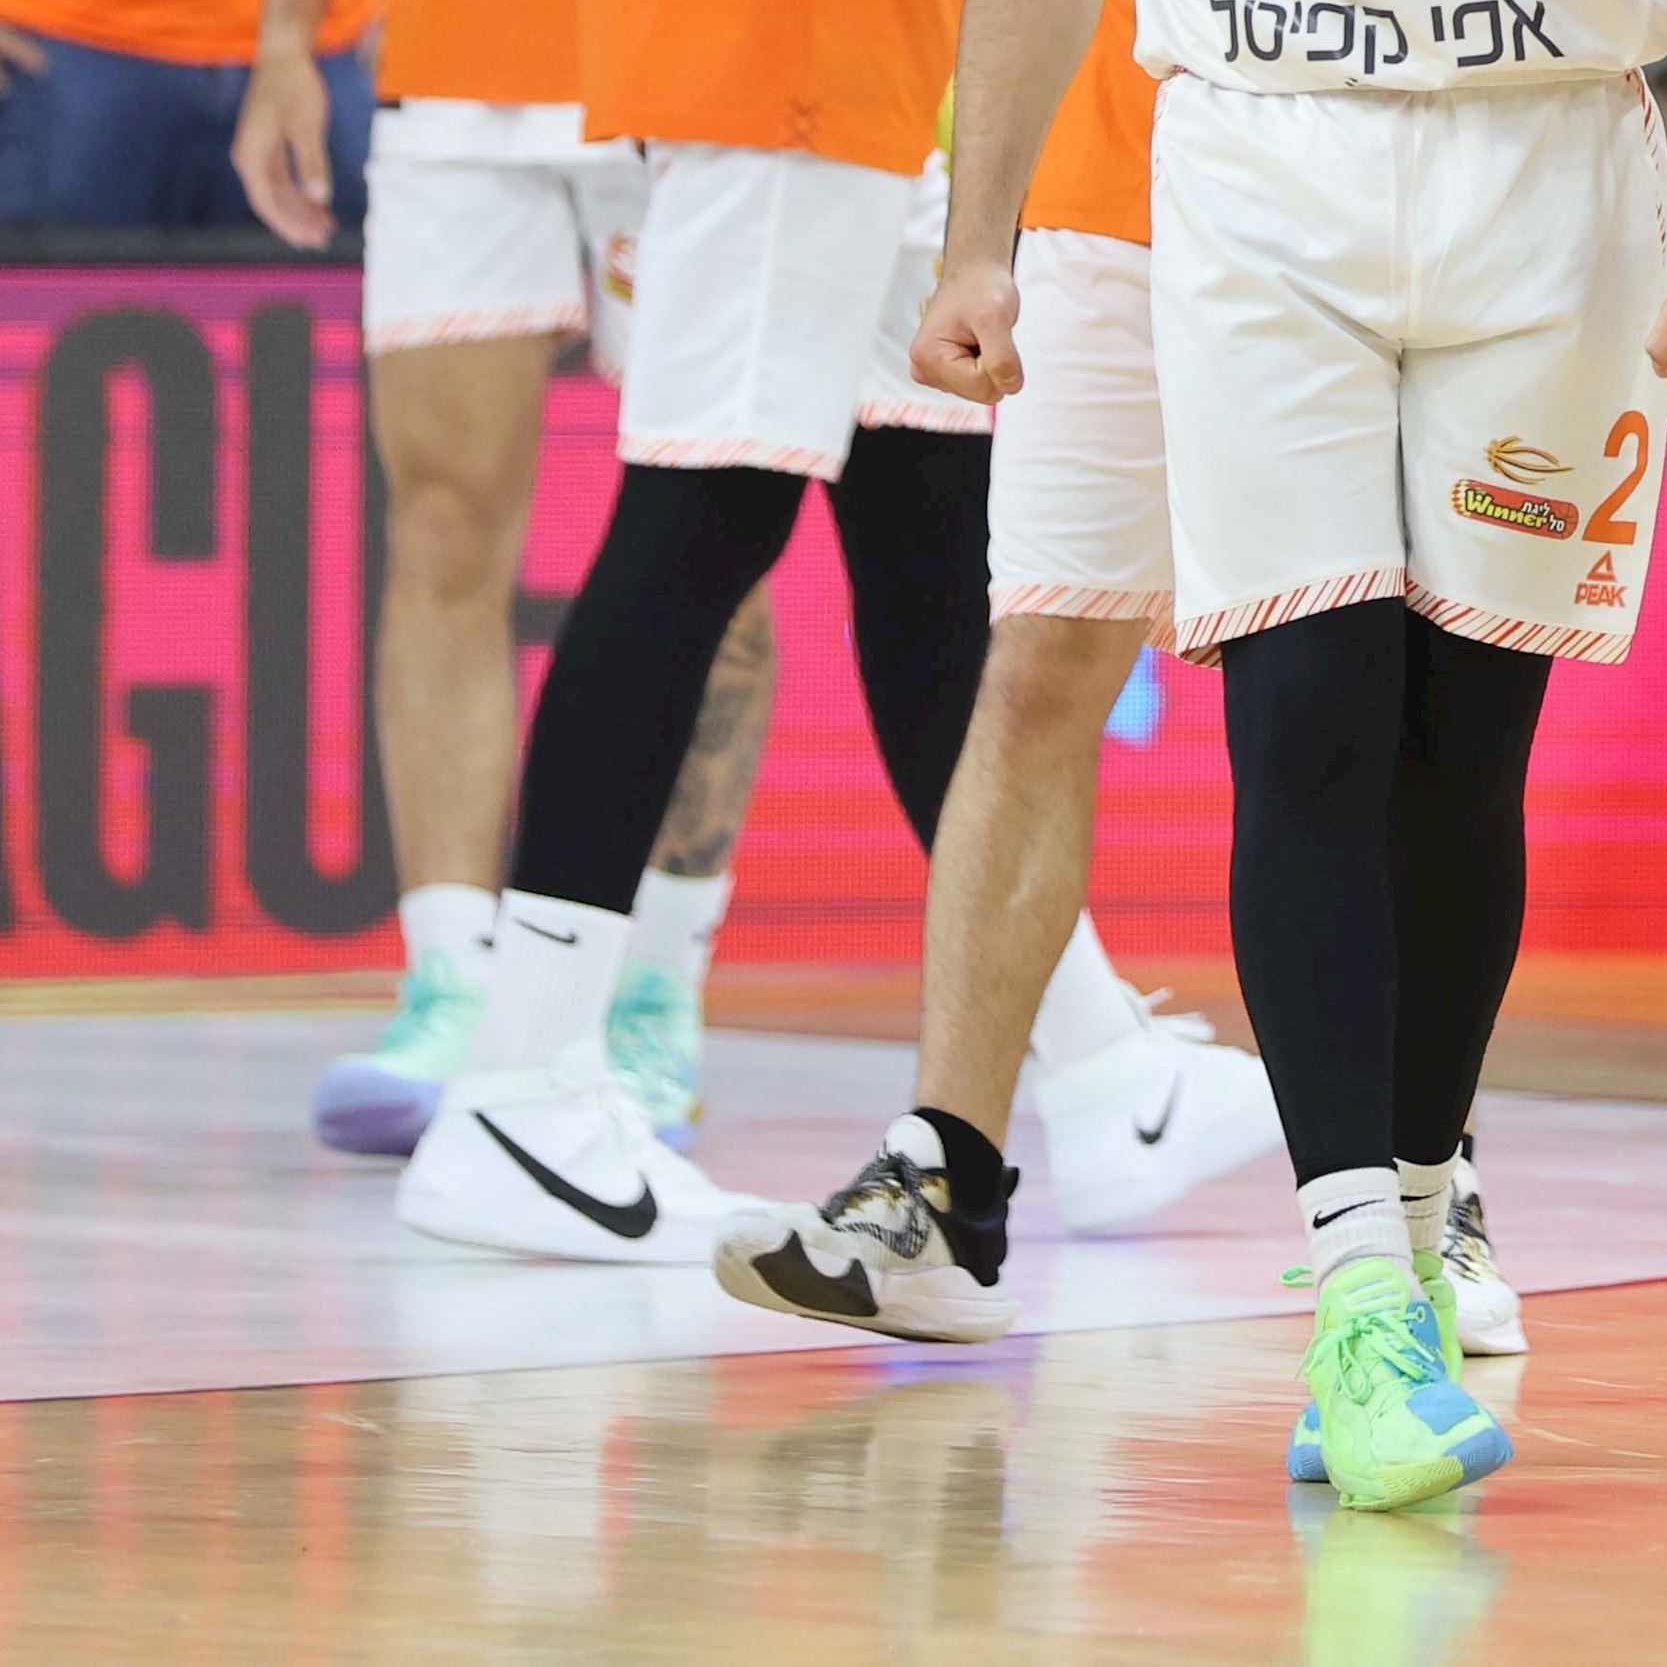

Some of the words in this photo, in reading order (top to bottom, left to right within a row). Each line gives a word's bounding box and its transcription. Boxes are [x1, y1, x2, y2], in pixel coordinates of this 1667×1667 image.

[1581, 409, 1650, 546] 2
[1465, 489, 1548, 530] Winner
[1549, 512, 1566, 533] סל
[1521, 500, 1551, 517] ליגת
[1573, 582, 1628, 608] PEAK
